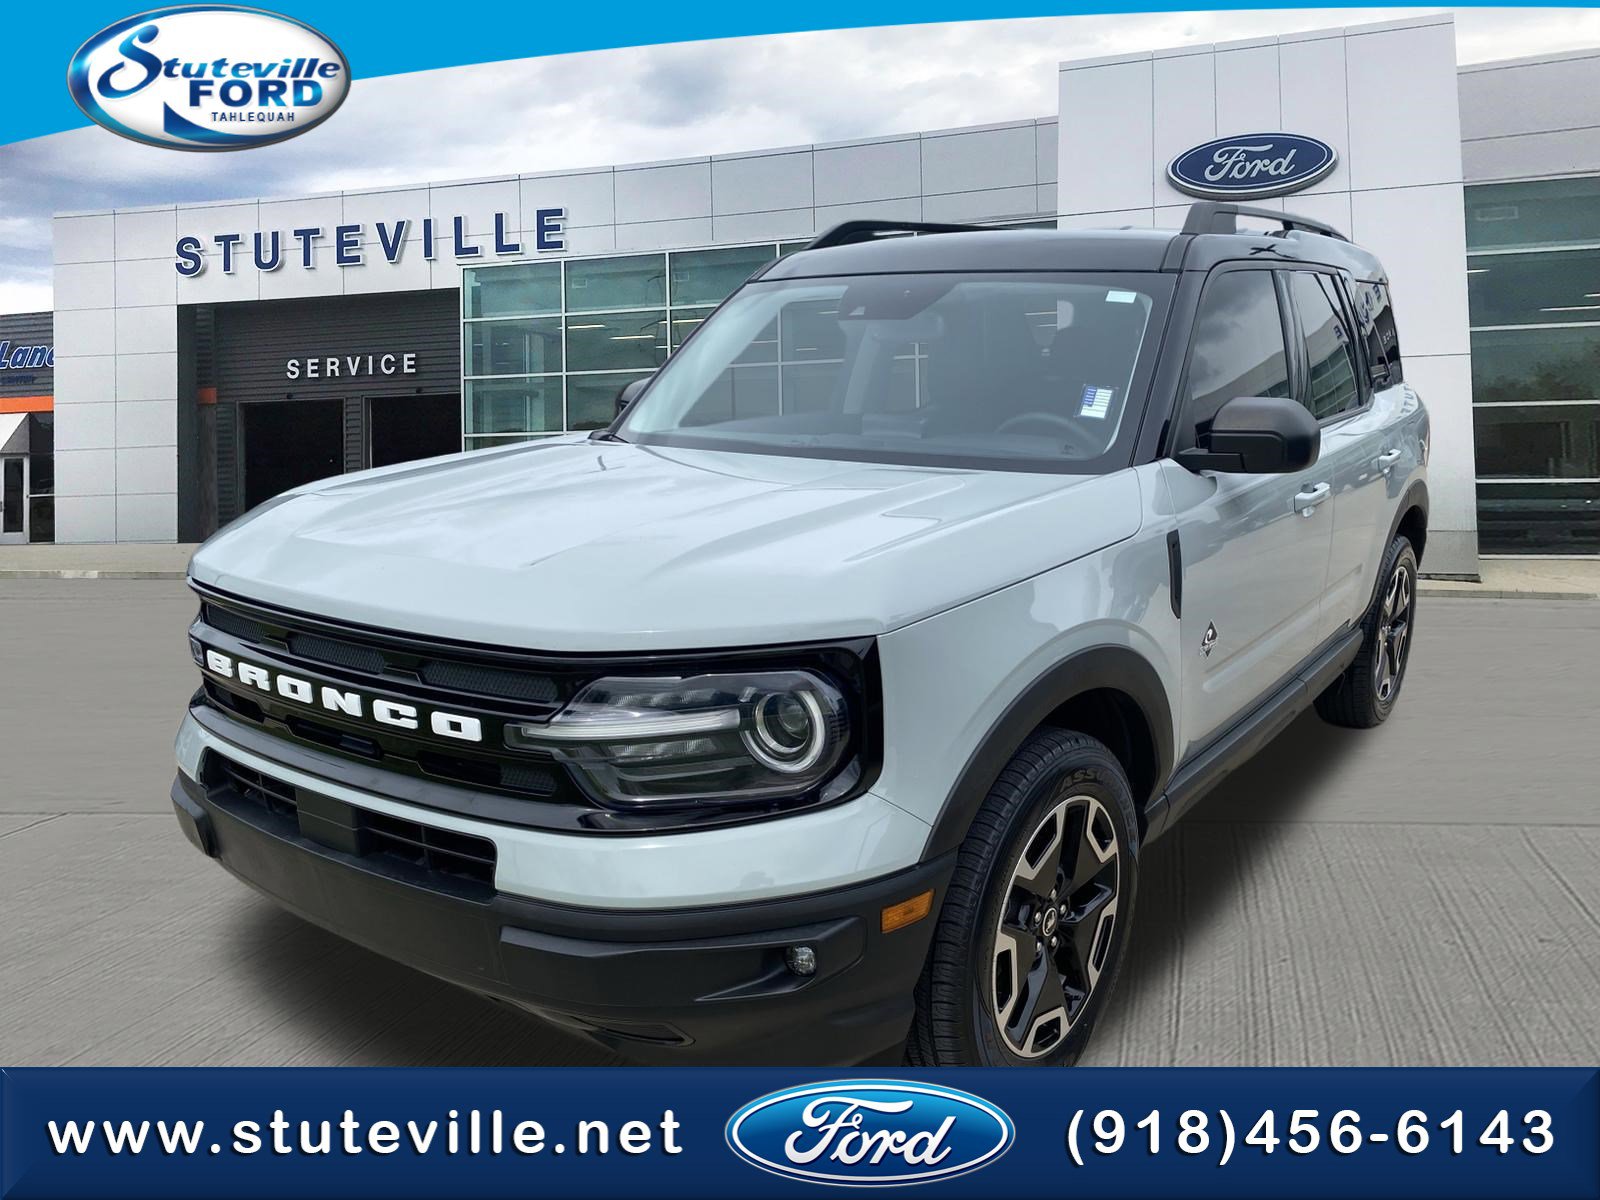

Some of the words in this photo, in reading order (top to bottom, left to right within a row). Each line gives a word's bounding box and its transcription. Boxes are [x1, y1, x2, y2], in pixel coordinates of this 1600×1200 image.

[1204, 143, 1296, 182] Ford
[174, 207, 568, 277] STUTEVILLE
[286, 353, 417, 379] SERVICE
[206, 649, 483, 742] BRONCO
